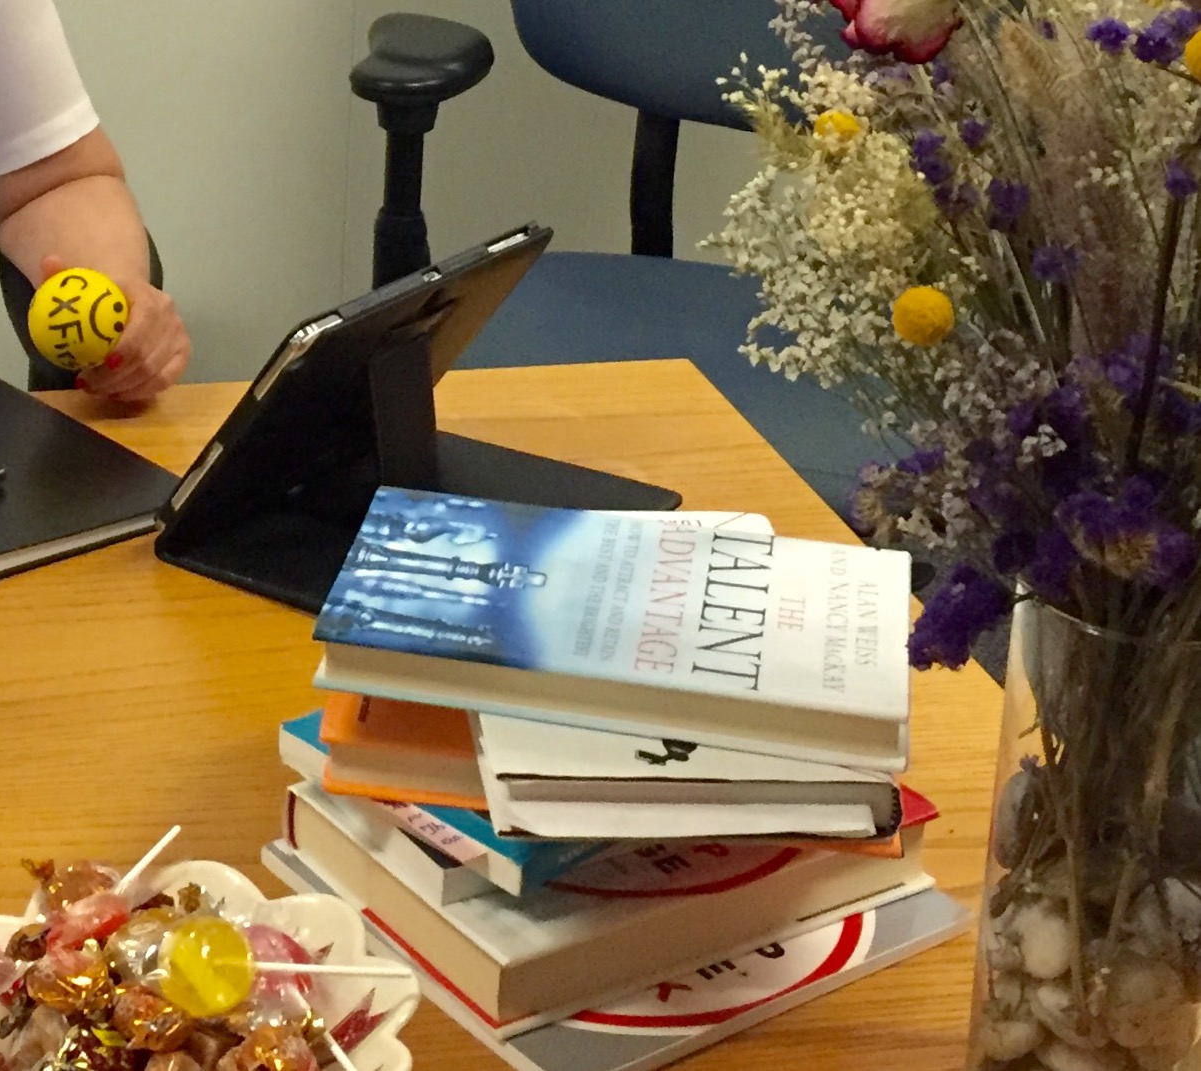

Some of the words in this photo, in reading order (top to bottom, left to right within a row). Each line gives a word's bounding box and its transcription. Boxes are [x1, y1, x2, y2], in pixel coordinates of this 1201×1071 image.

[613, 559, 635, 604] ATTRACT
[634, 525, 697, 674] ADVANTAGE
[857, 579, 879, 620] ALAN
[607, 605, 625, 626] AND
[691, 531, 775, 692] TALENT
[777, 595, 806, 632] THE
[826, 581, 849, 633] NANCY
[855, 625, 879, 667] WEISS
